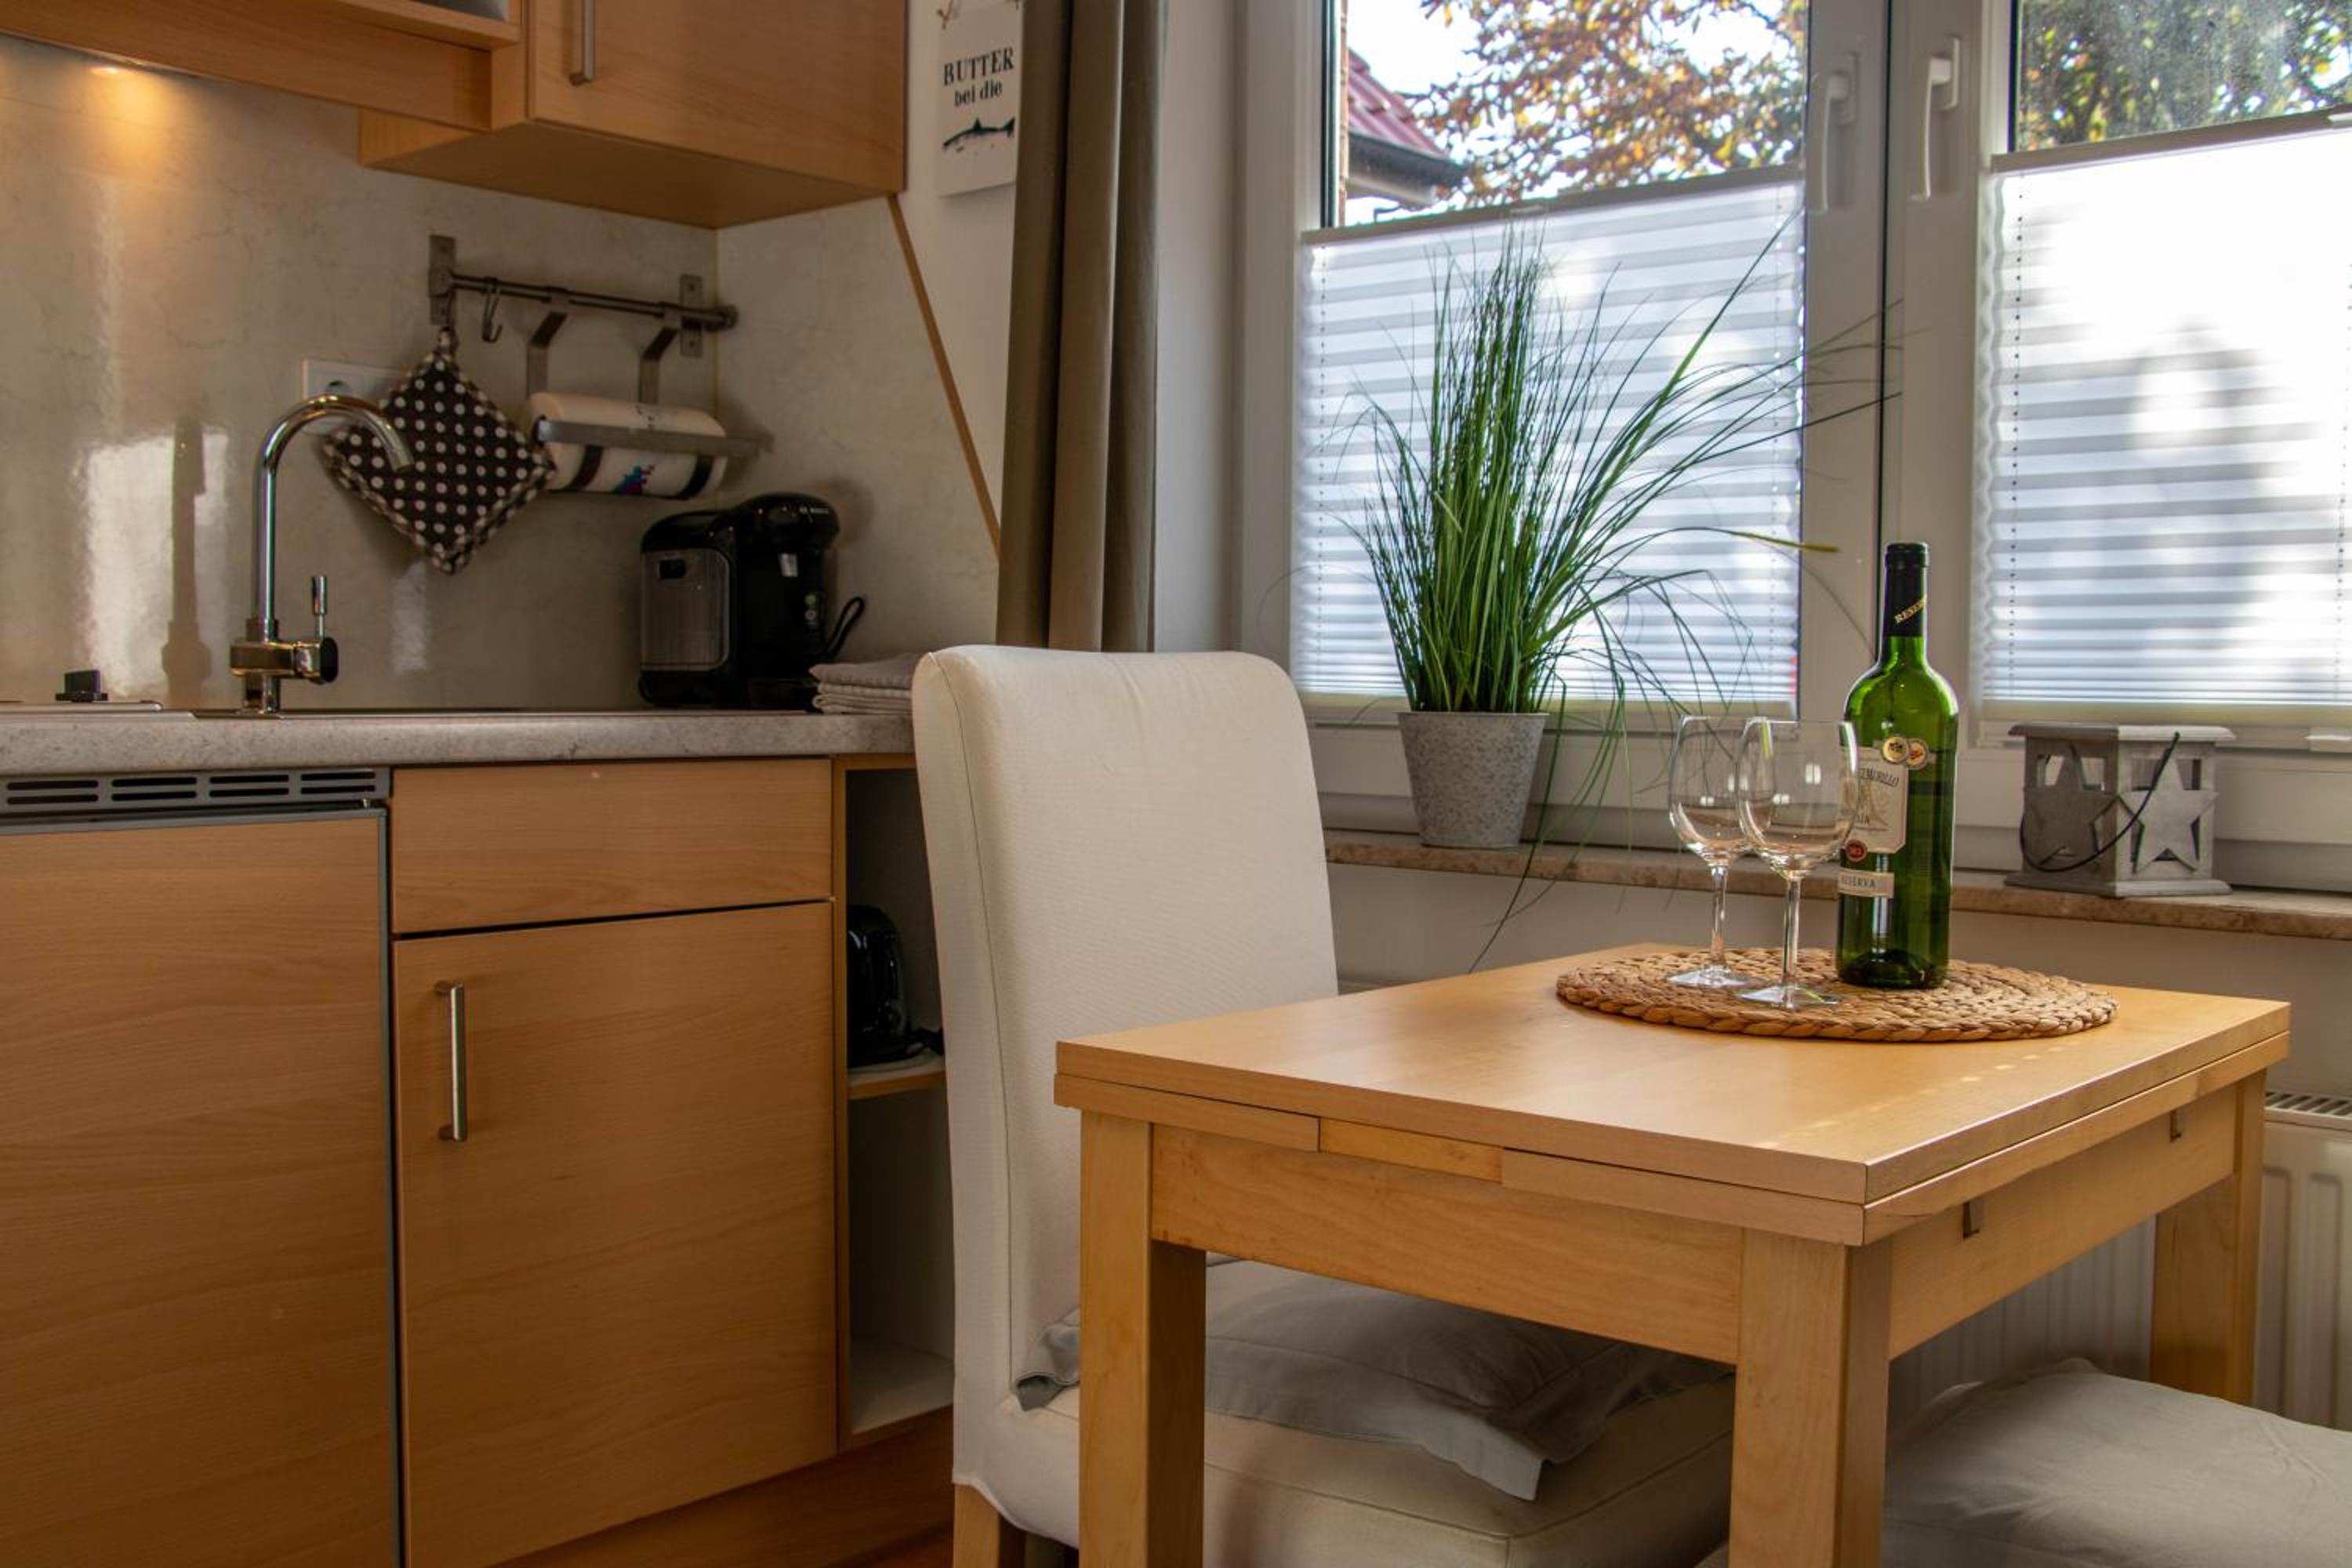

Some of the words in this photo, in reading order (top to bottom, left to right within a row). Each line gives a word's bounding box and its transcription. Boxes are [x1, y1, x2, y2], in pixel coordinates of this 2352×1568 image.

[943, 47, 1014, 85] BUTTER
[954, 85, 975, 107] bei
[980, 80, 1003, 100] die
